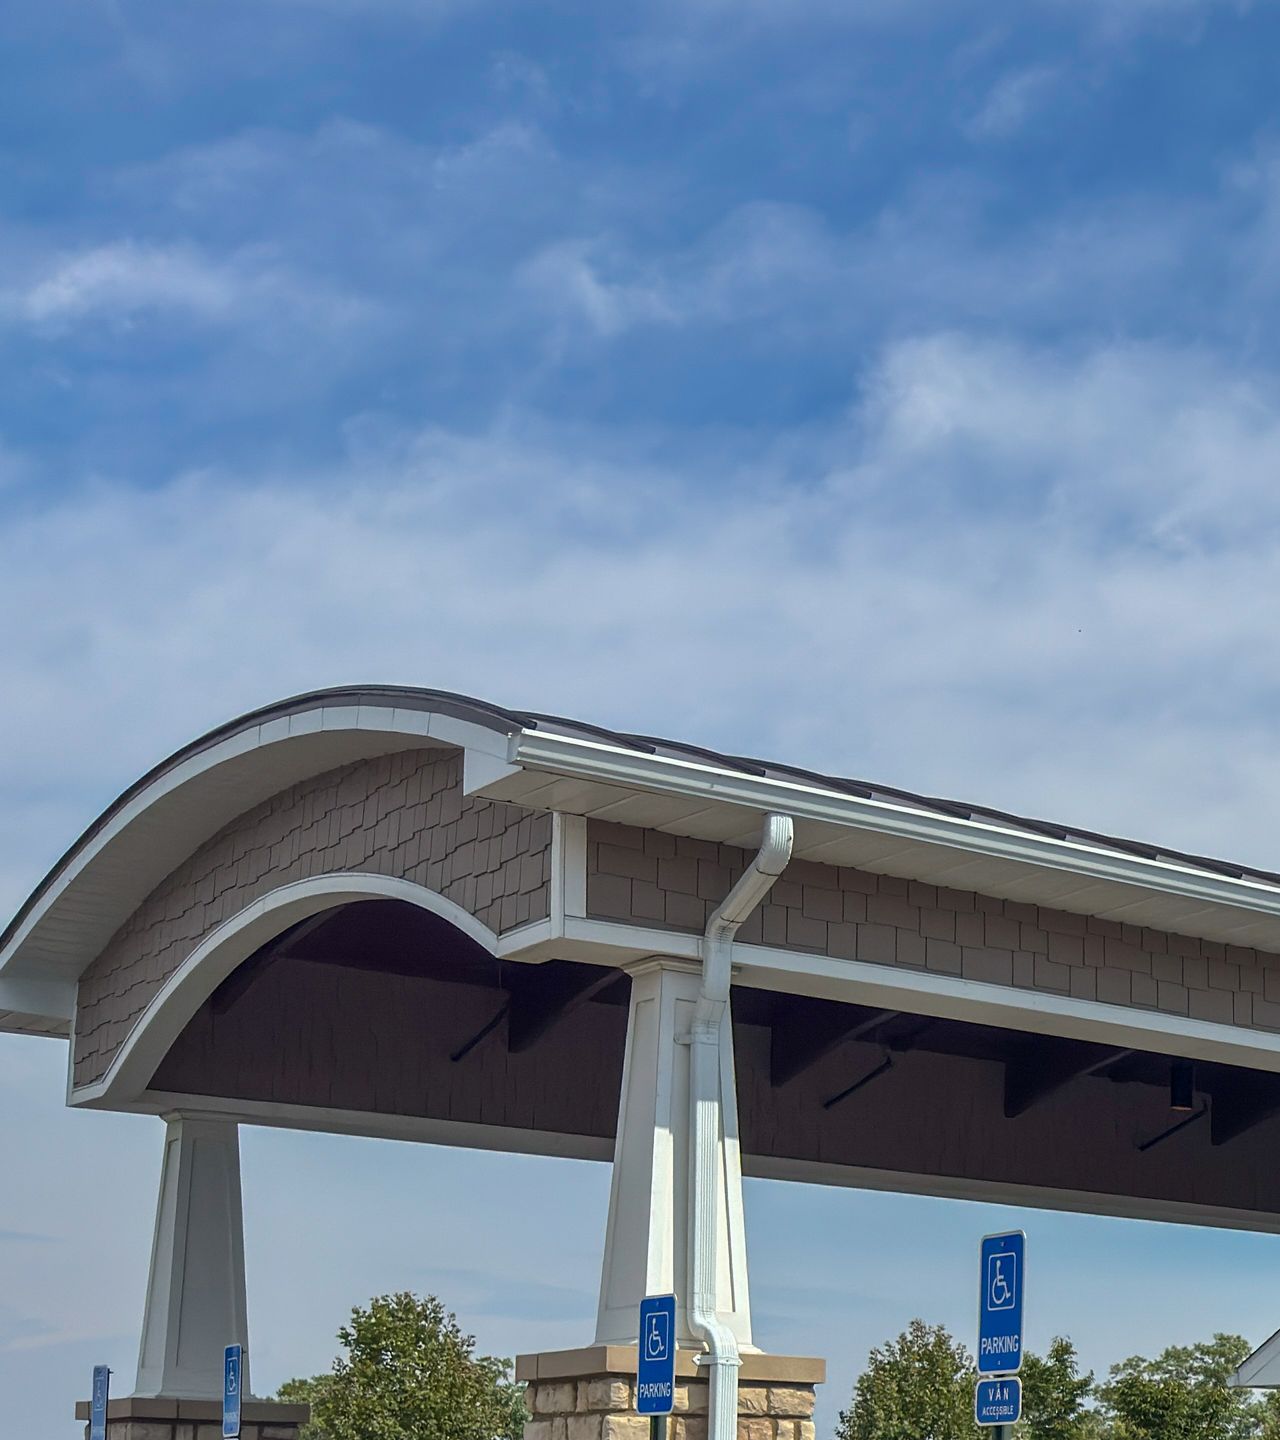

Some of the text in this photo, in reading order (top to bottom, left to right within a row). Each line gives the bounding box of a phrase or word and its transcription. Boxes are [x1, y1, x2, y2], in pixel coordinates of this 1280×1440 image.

[981, 1335, 1019, 1355] PARKING
[639, 1382, 671, 1398] PARKING
[988, 1387, 1009, 1401] VAN
[982, 1405, 1014, 1416] ACCESSIBLE
